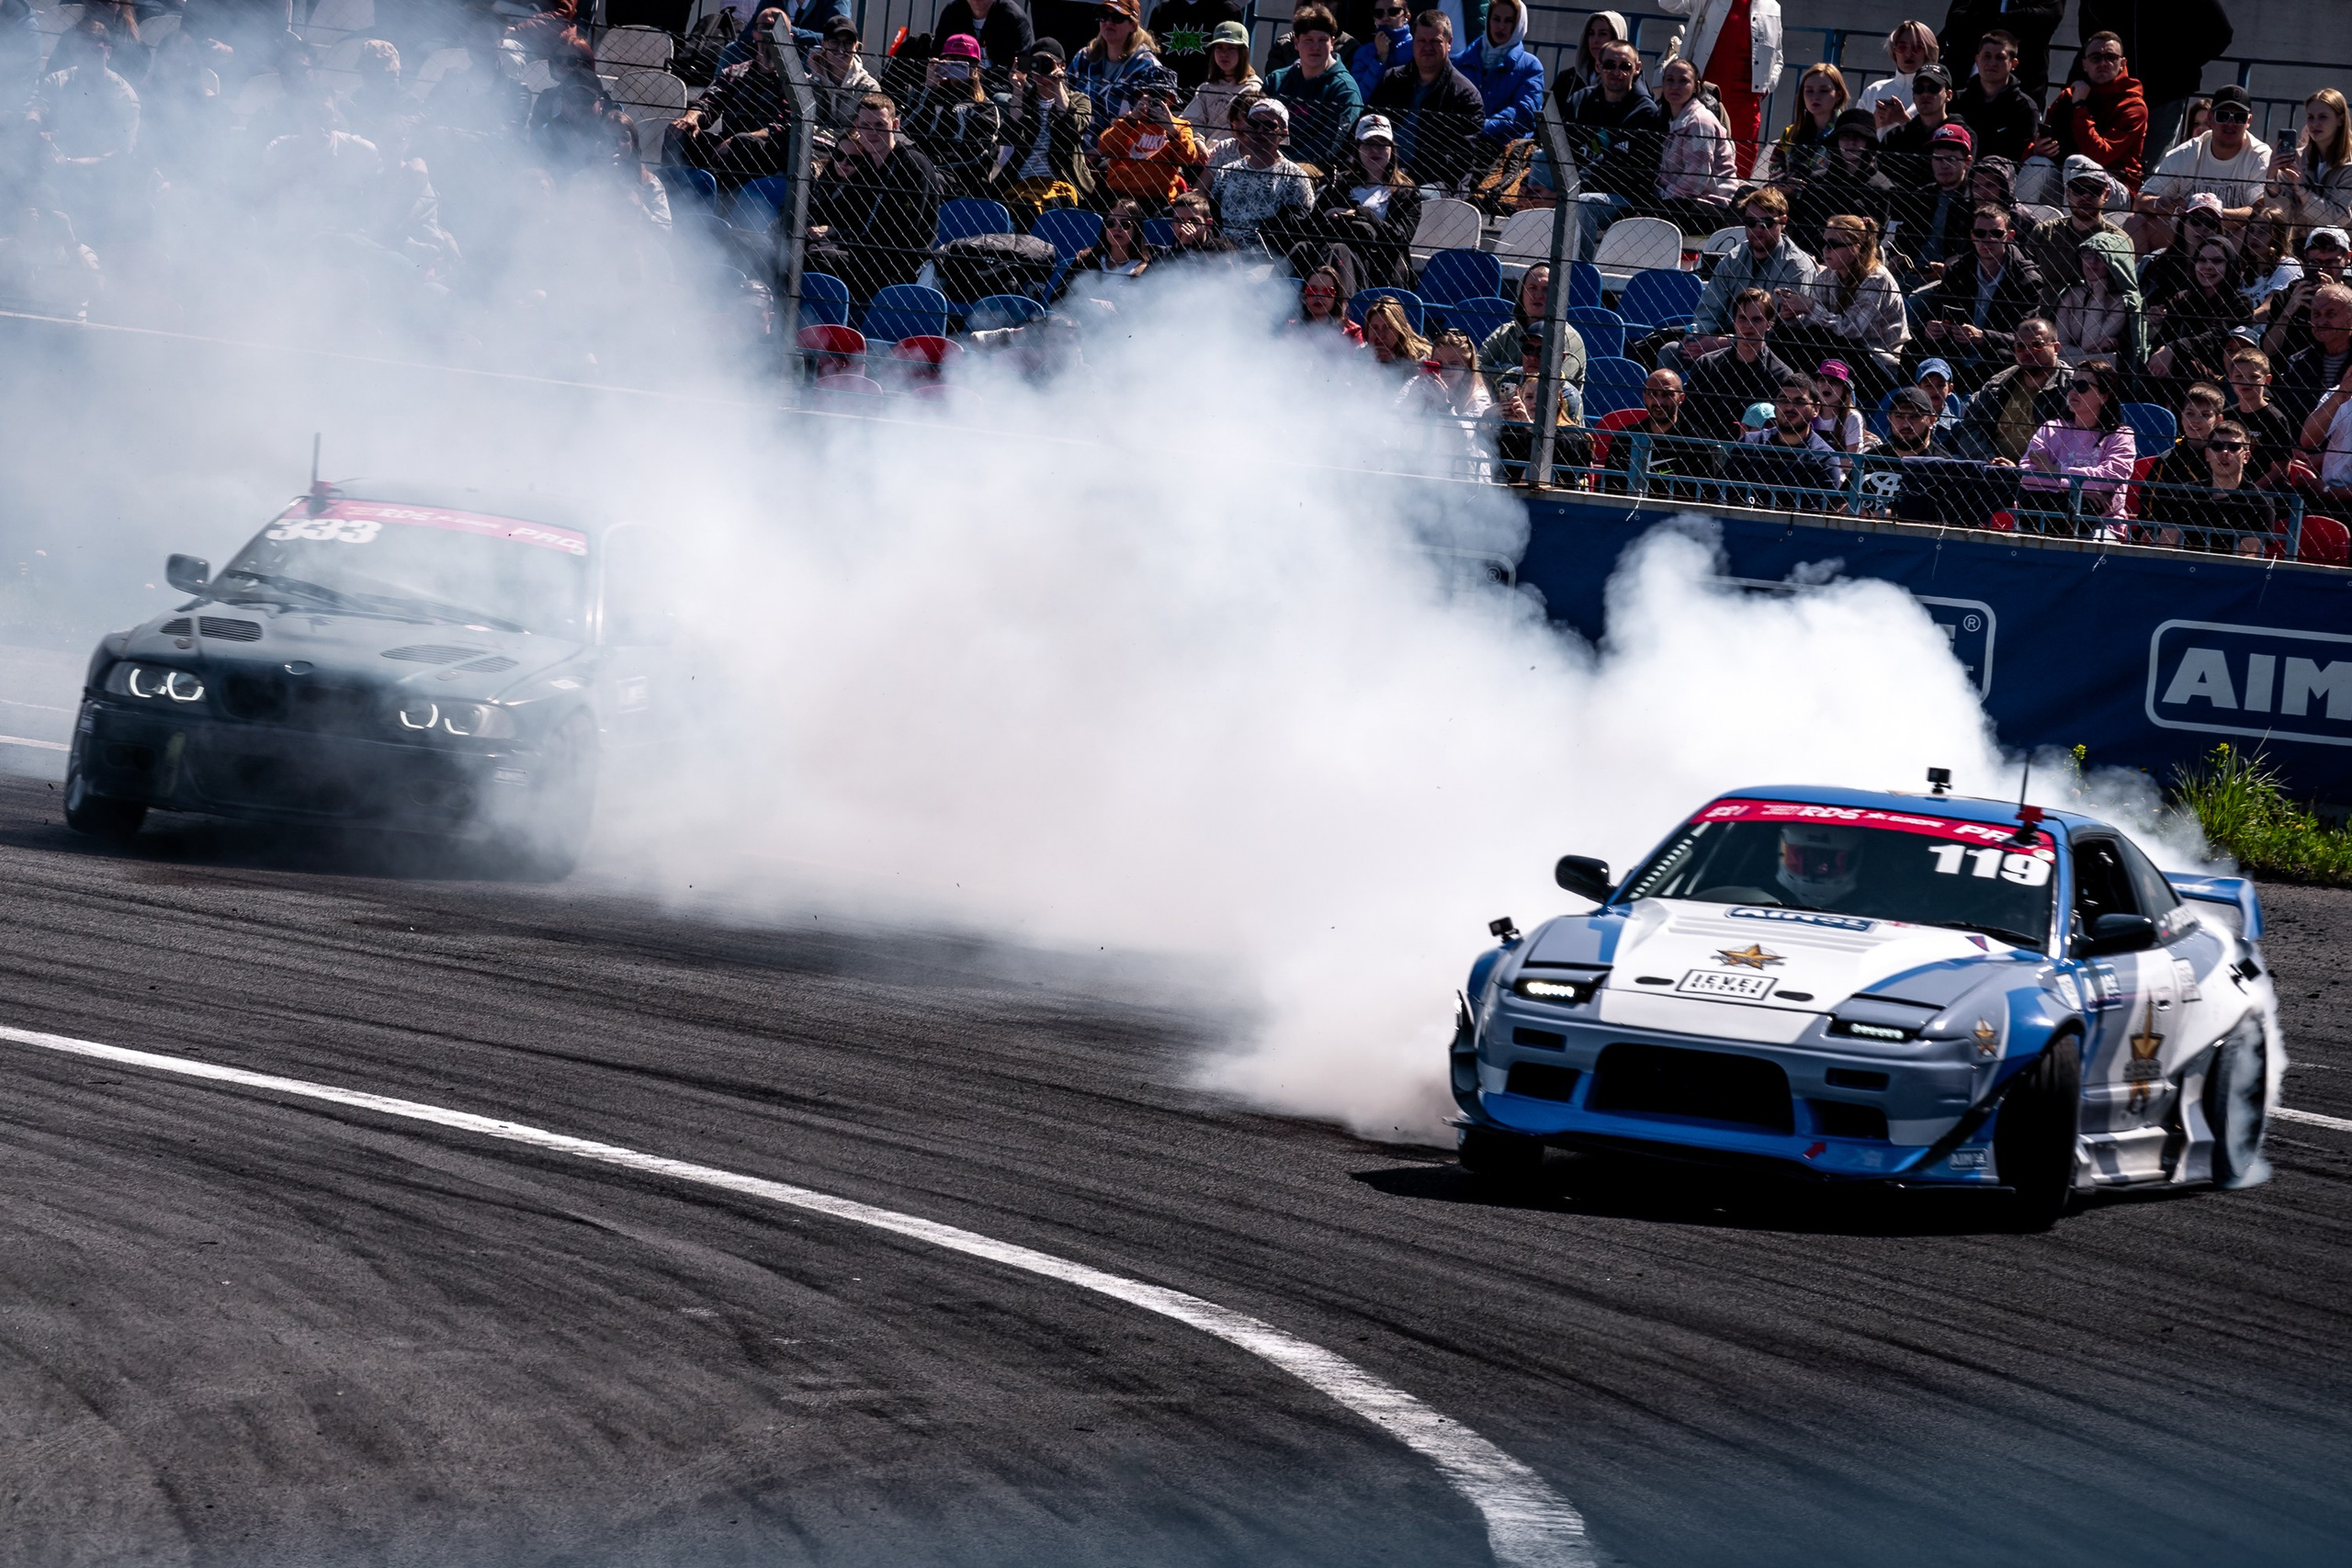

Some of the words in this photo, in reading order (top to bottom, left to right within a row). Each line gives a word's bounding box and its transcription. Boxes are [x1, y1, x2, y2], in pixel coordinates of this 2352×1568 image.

[266, 518, 382, 544] 333
[2162, 647, 2352, 721] AIM
[1798, 806, 1866, 820] RDS
[1928, 844, 2052, 886] 119
